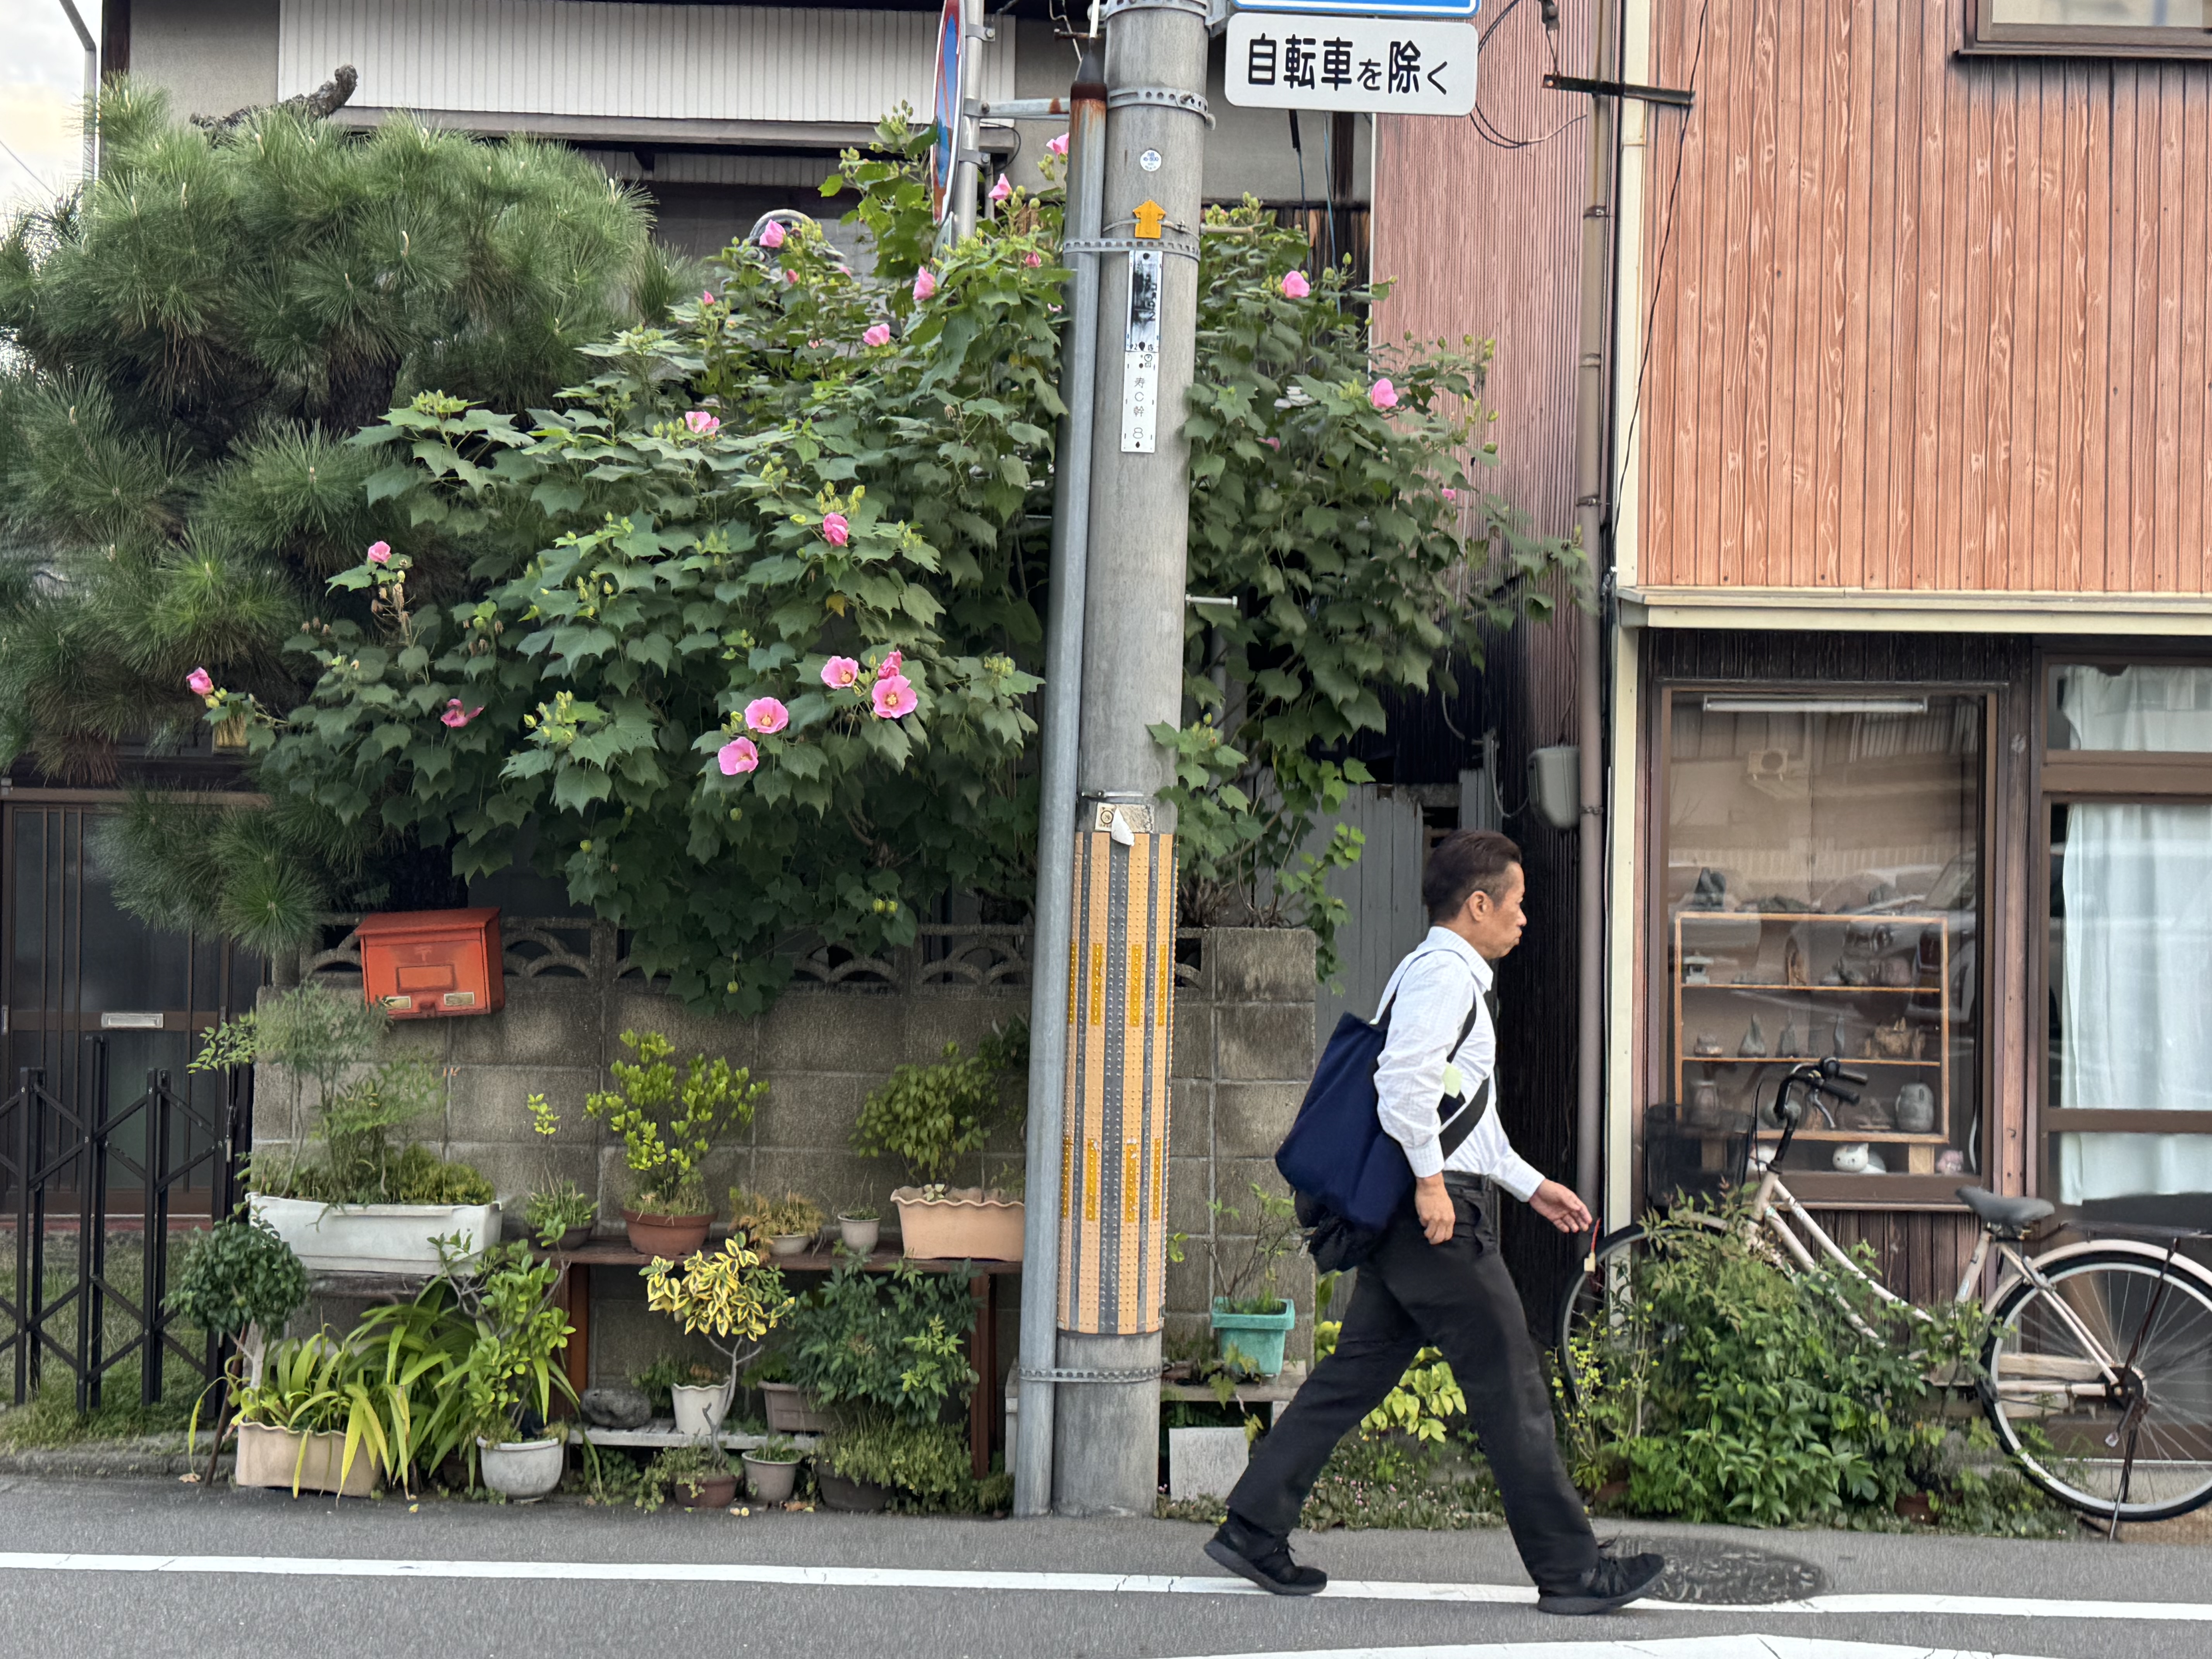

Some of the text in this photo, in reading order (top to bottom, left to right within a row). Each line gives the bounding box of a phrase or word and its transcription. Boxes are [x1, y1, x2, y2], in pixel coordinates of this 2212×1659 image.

[1248, 33, 1448, 95] 自転車を除く
